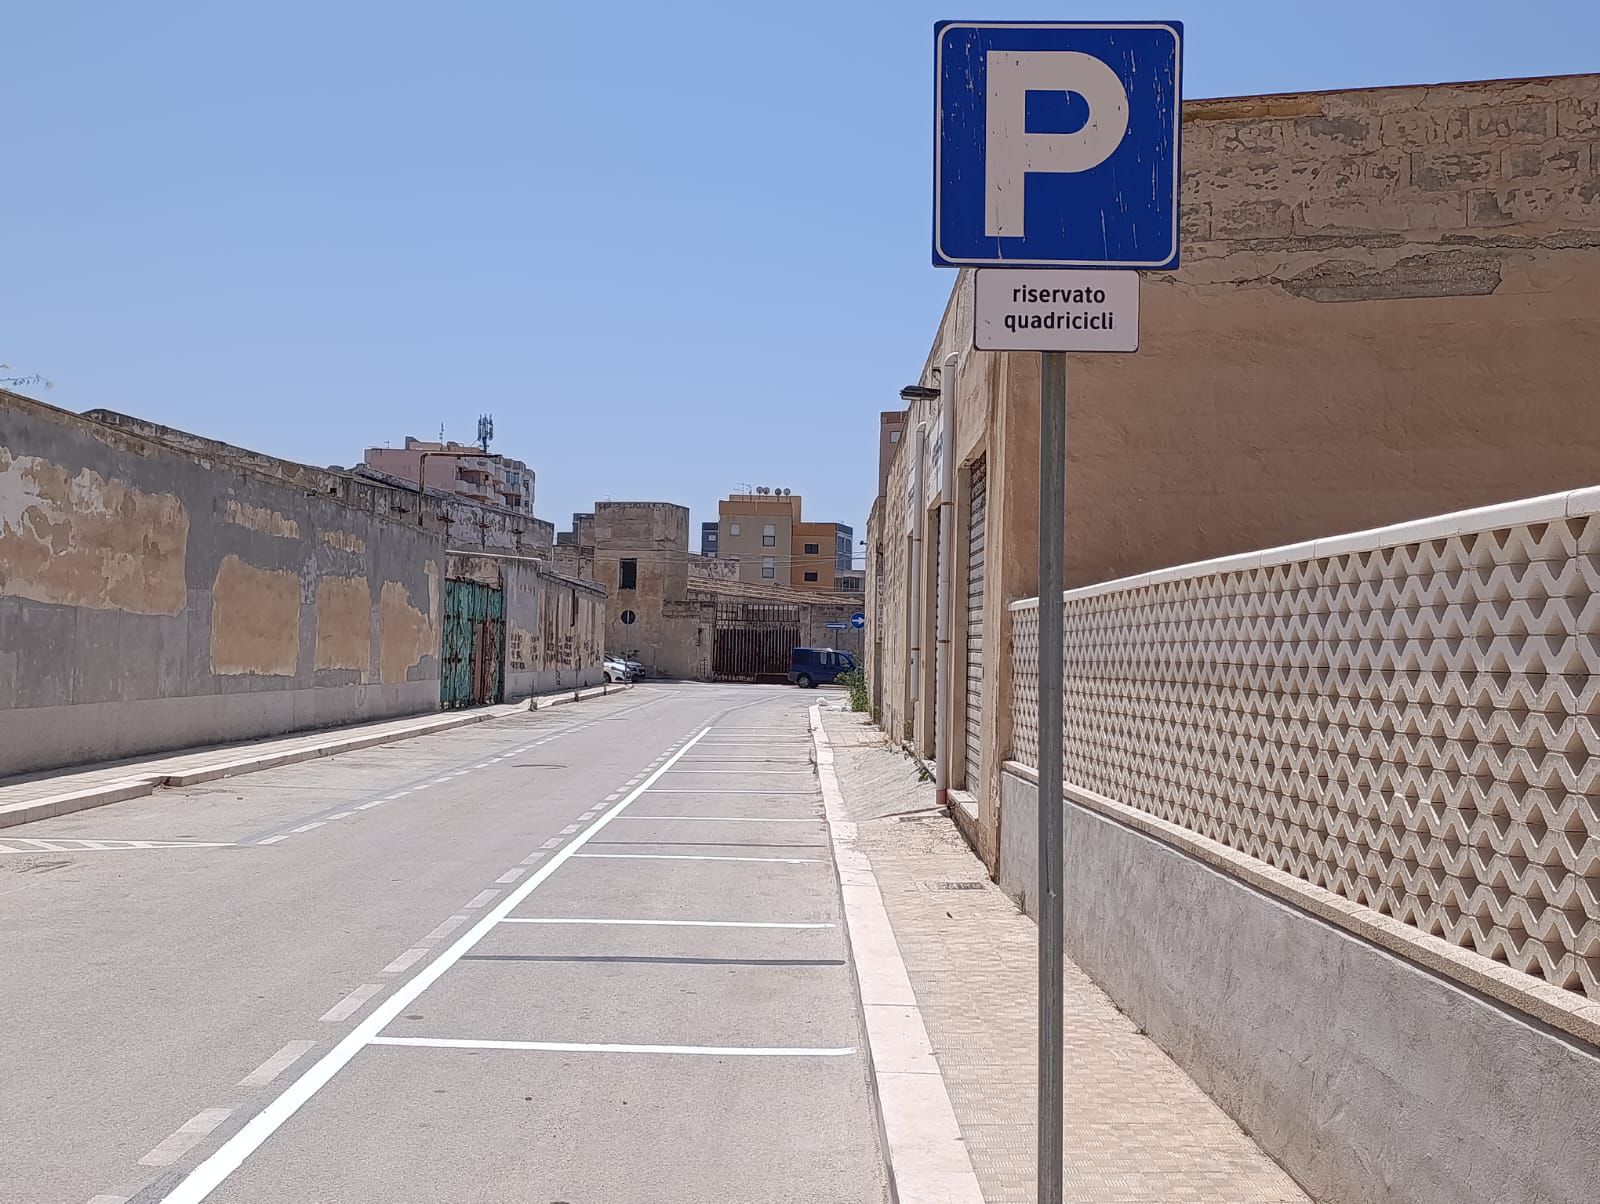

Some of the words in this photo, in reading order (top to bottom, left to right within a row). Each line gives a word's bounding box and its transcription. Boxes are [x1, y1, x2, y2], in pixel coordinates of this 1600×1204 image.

[985, 50, 1129, 237] P
[1012, 284, 1106, 304] riservato
[1004, 311, 1114, 333] quadricicli
